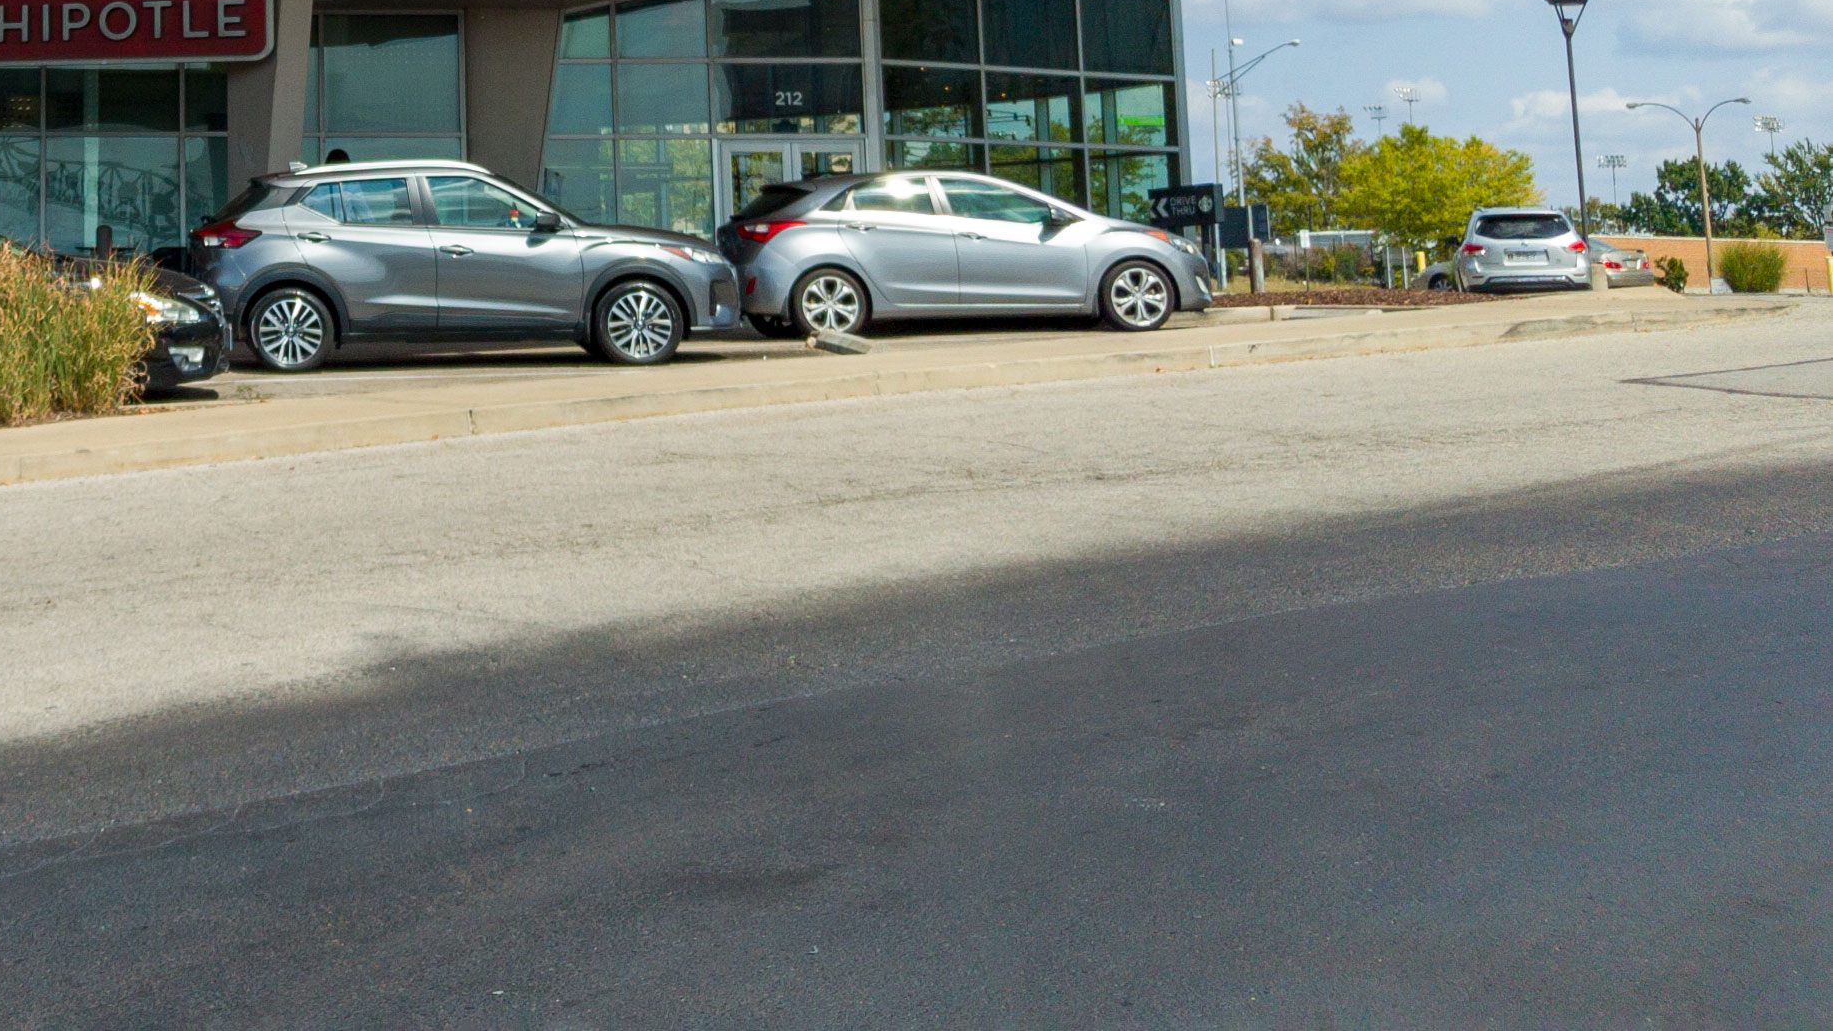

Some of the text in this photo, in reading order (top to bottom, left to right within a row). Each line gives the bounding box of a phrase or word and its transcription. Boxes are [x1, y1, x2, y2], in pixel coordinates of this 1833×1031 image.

[775, 91, 803, 106] 212
[1170, 195, 1196, 206] DRIVE
[1171, 205, 1195, 216] THRU
